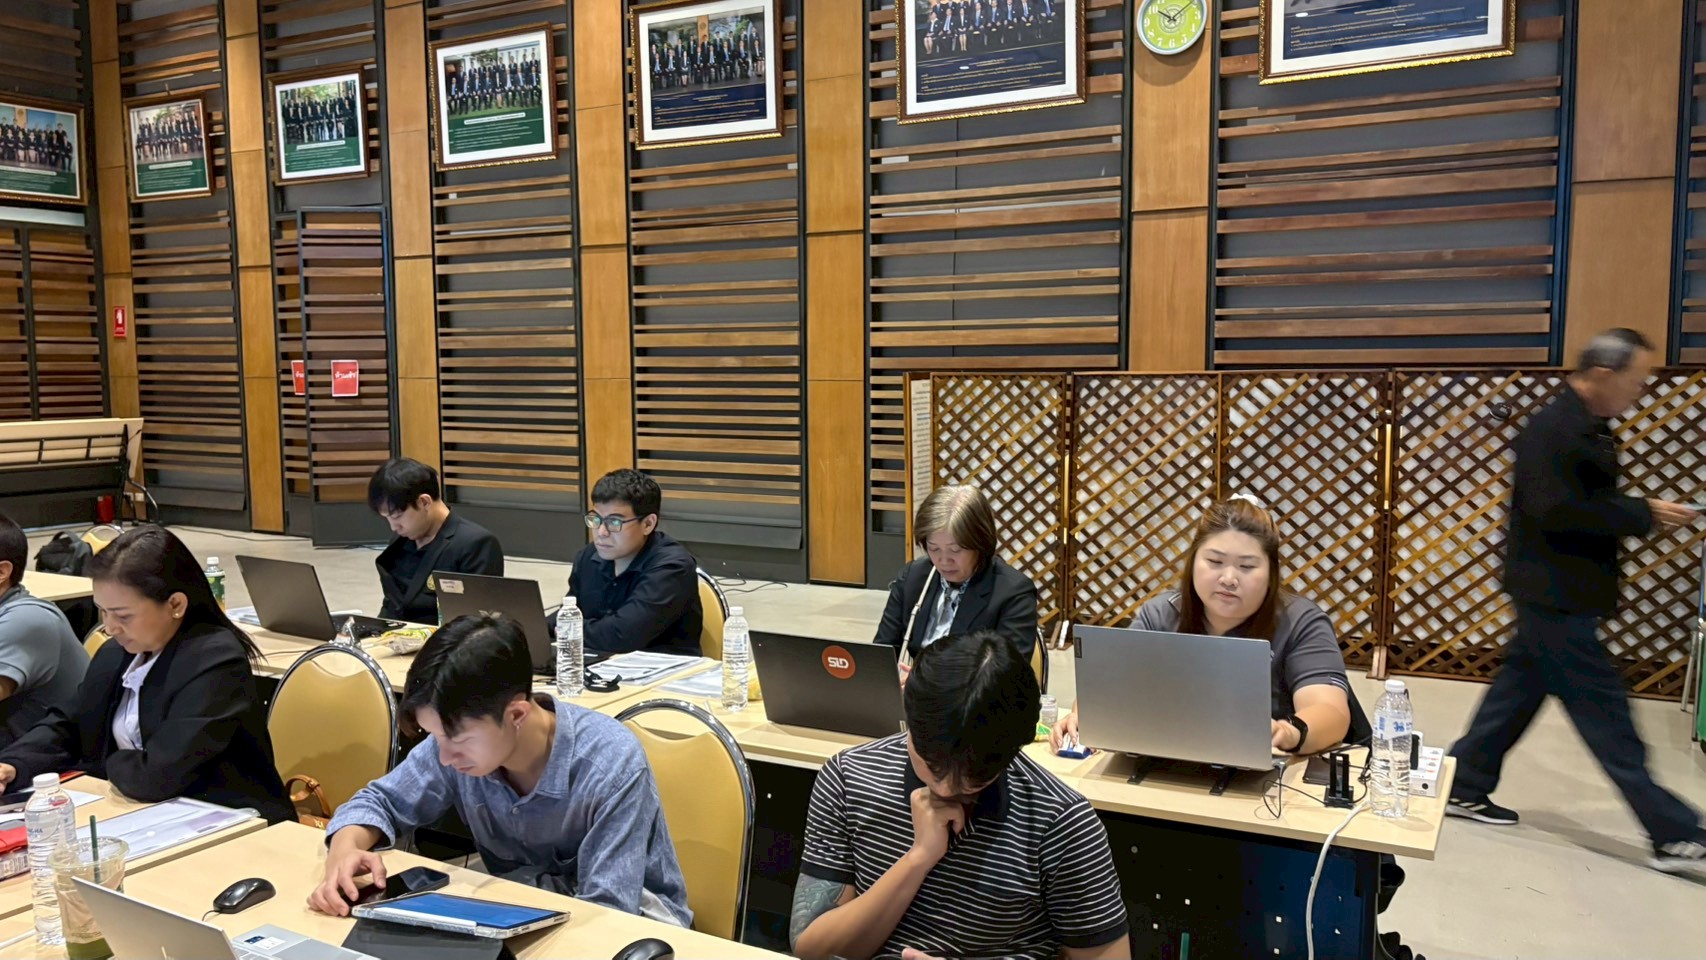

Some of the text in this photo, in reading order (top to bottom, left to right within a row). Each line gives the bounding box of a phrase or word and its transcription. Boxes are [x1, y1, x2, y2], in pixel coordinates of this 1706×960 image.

[1148, 5, 1159, 15] 10
[1194, 10, 1201, 20] 3
[1144, 17, 1151, 28] 9
[1147, 28, 1155, 38] 8
[1190, 23, 1195, 33] 4
[1157, 37, 1163, 47] 7
[1181, 33, 1188, 43] 5
[1168, 39, 1175, 48] 6
